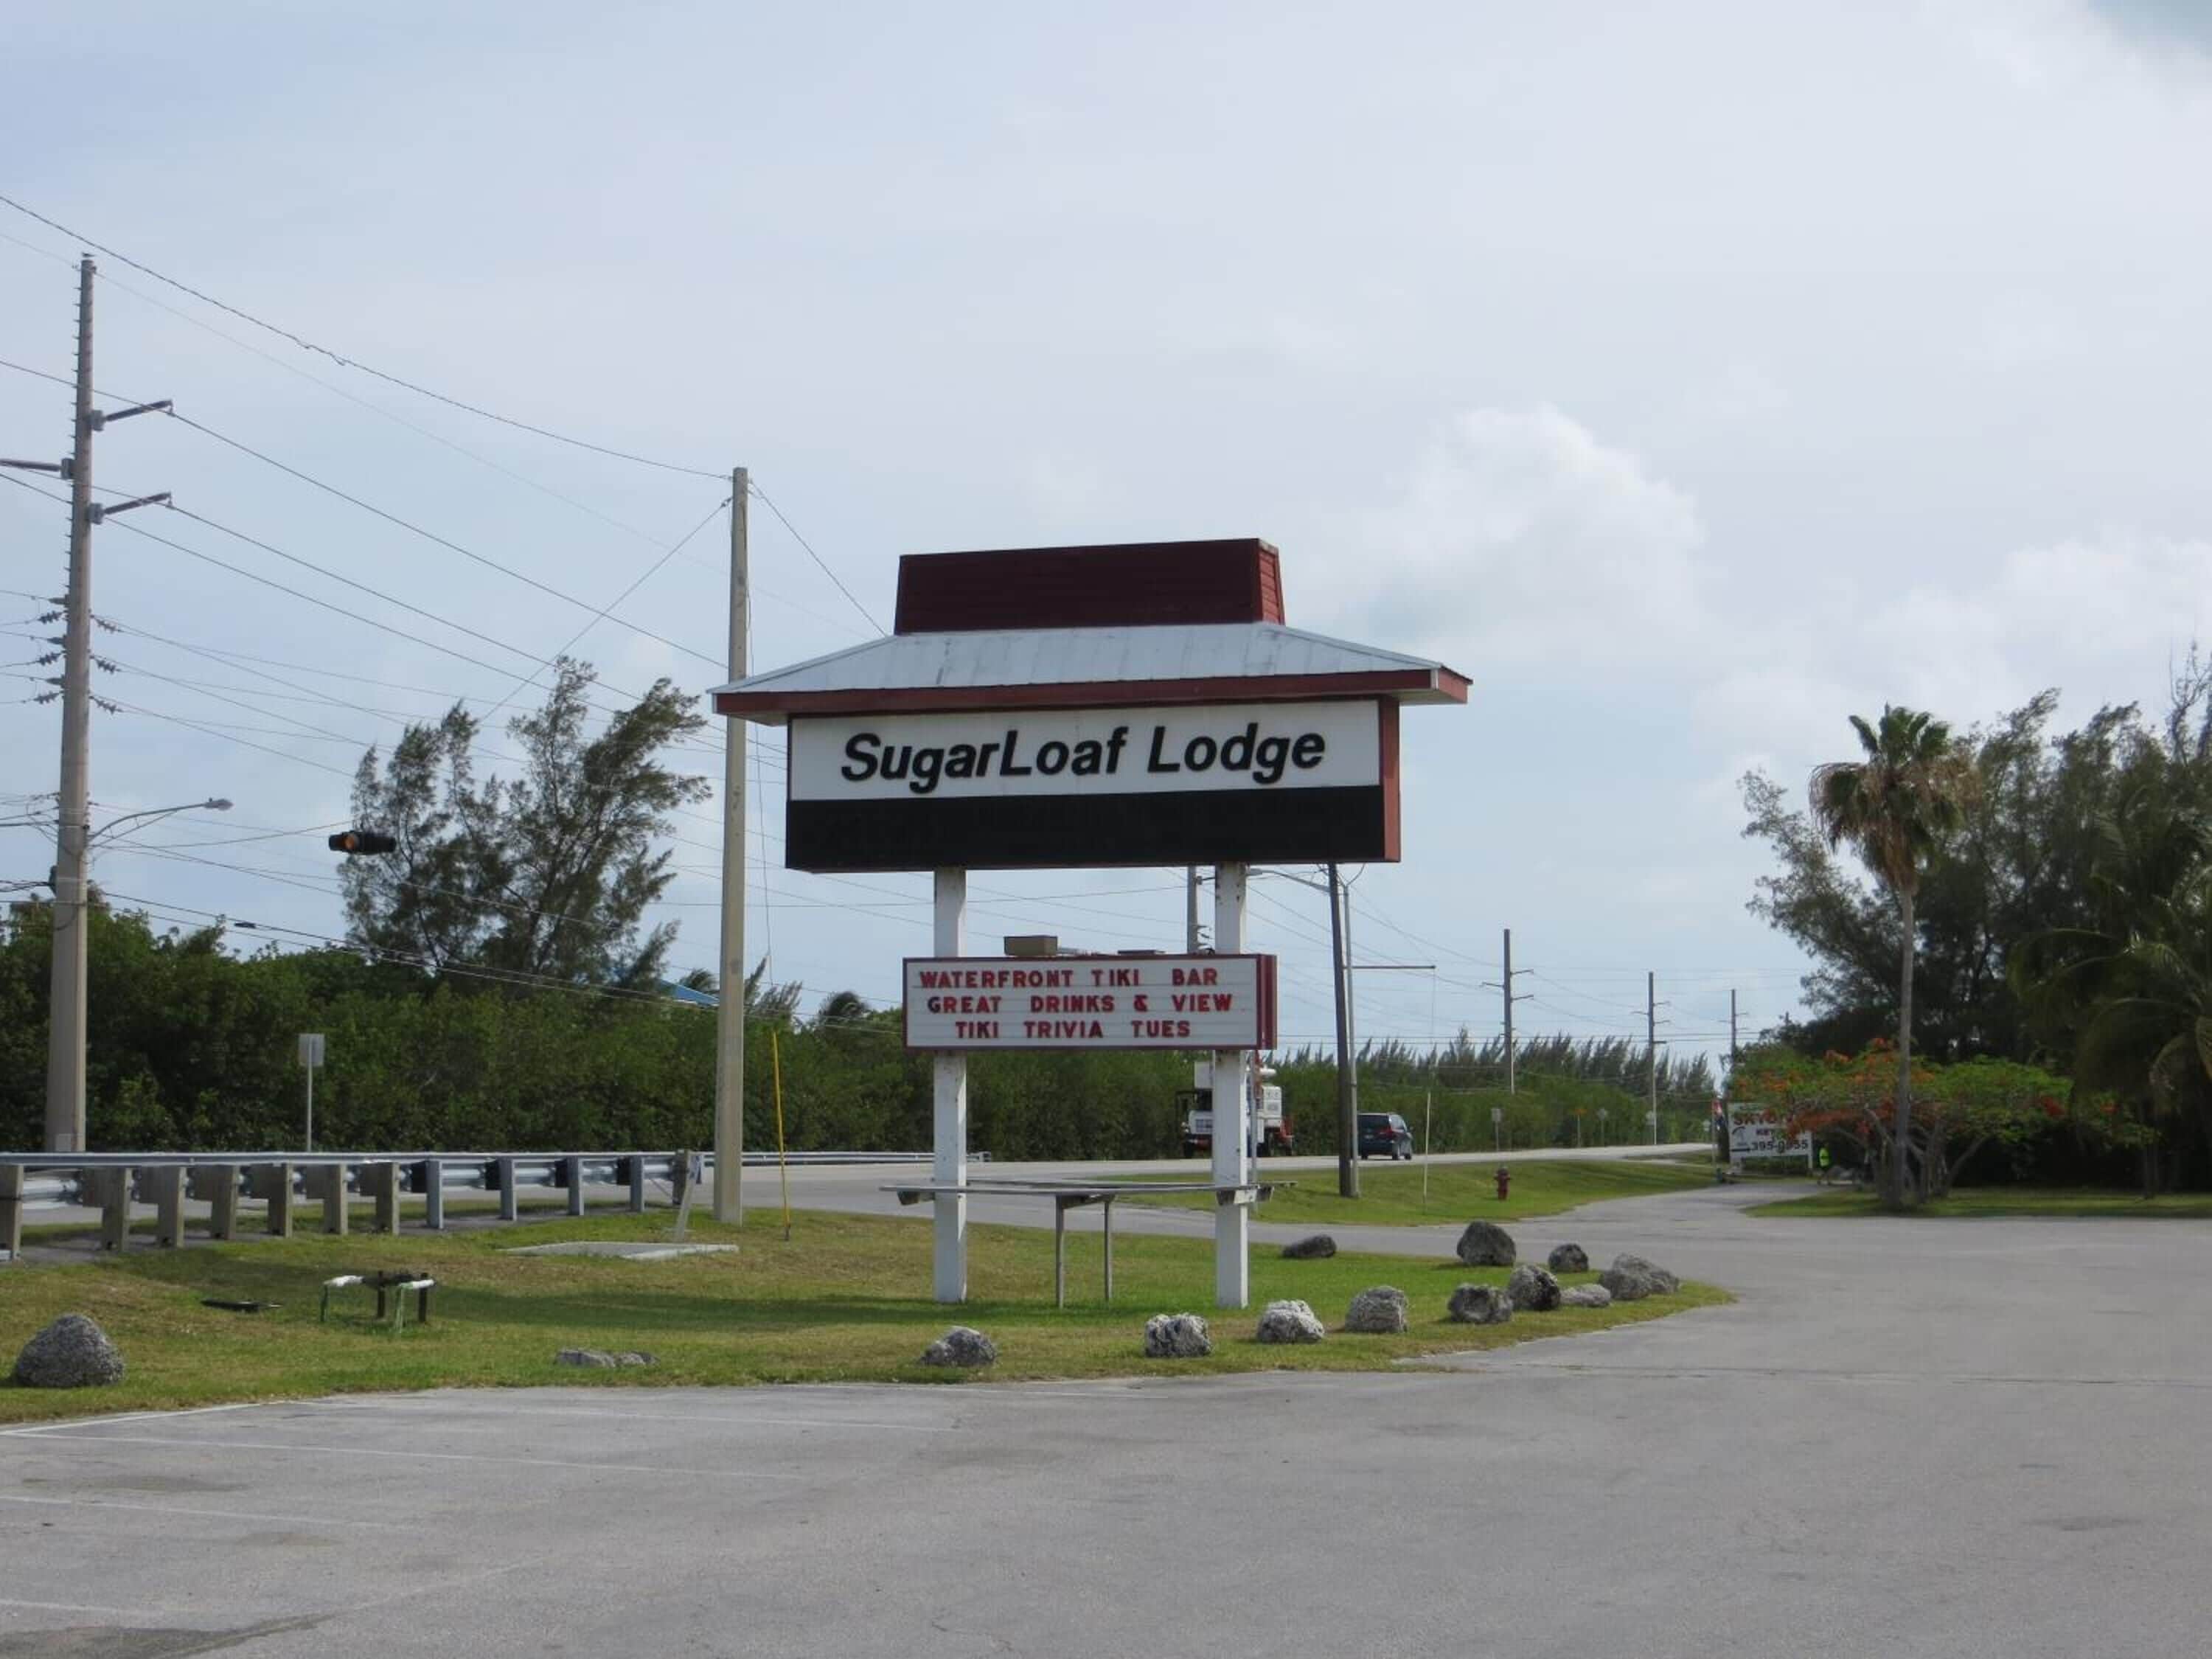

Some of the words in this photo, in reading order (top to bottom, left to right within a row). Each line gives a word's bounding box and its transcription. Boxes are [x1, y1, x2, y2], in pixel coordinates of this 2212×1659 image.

[841, 726, 1130, 793] SugarLoaf
[1147, 722, 1326, 785] Lodge
[919, 968, 1074, 990] WATERFRONT
[1091, 968, 1140, 987] TIKI
[1172, 967, 1218, 987] BAR
[927, 995, 1002, 1015] GREAT
[1030, 994, 1116, 1013] DRINKS
[1133, 993, 1149, 1013] &
[1171, 992, 1233, 1013] VIEW
[955, 1020, 1000, 1040] TIKI
[1023, 1020, 1105, 1040] TRIVIA
[1130, 1019, 1192, 1040] TUES
